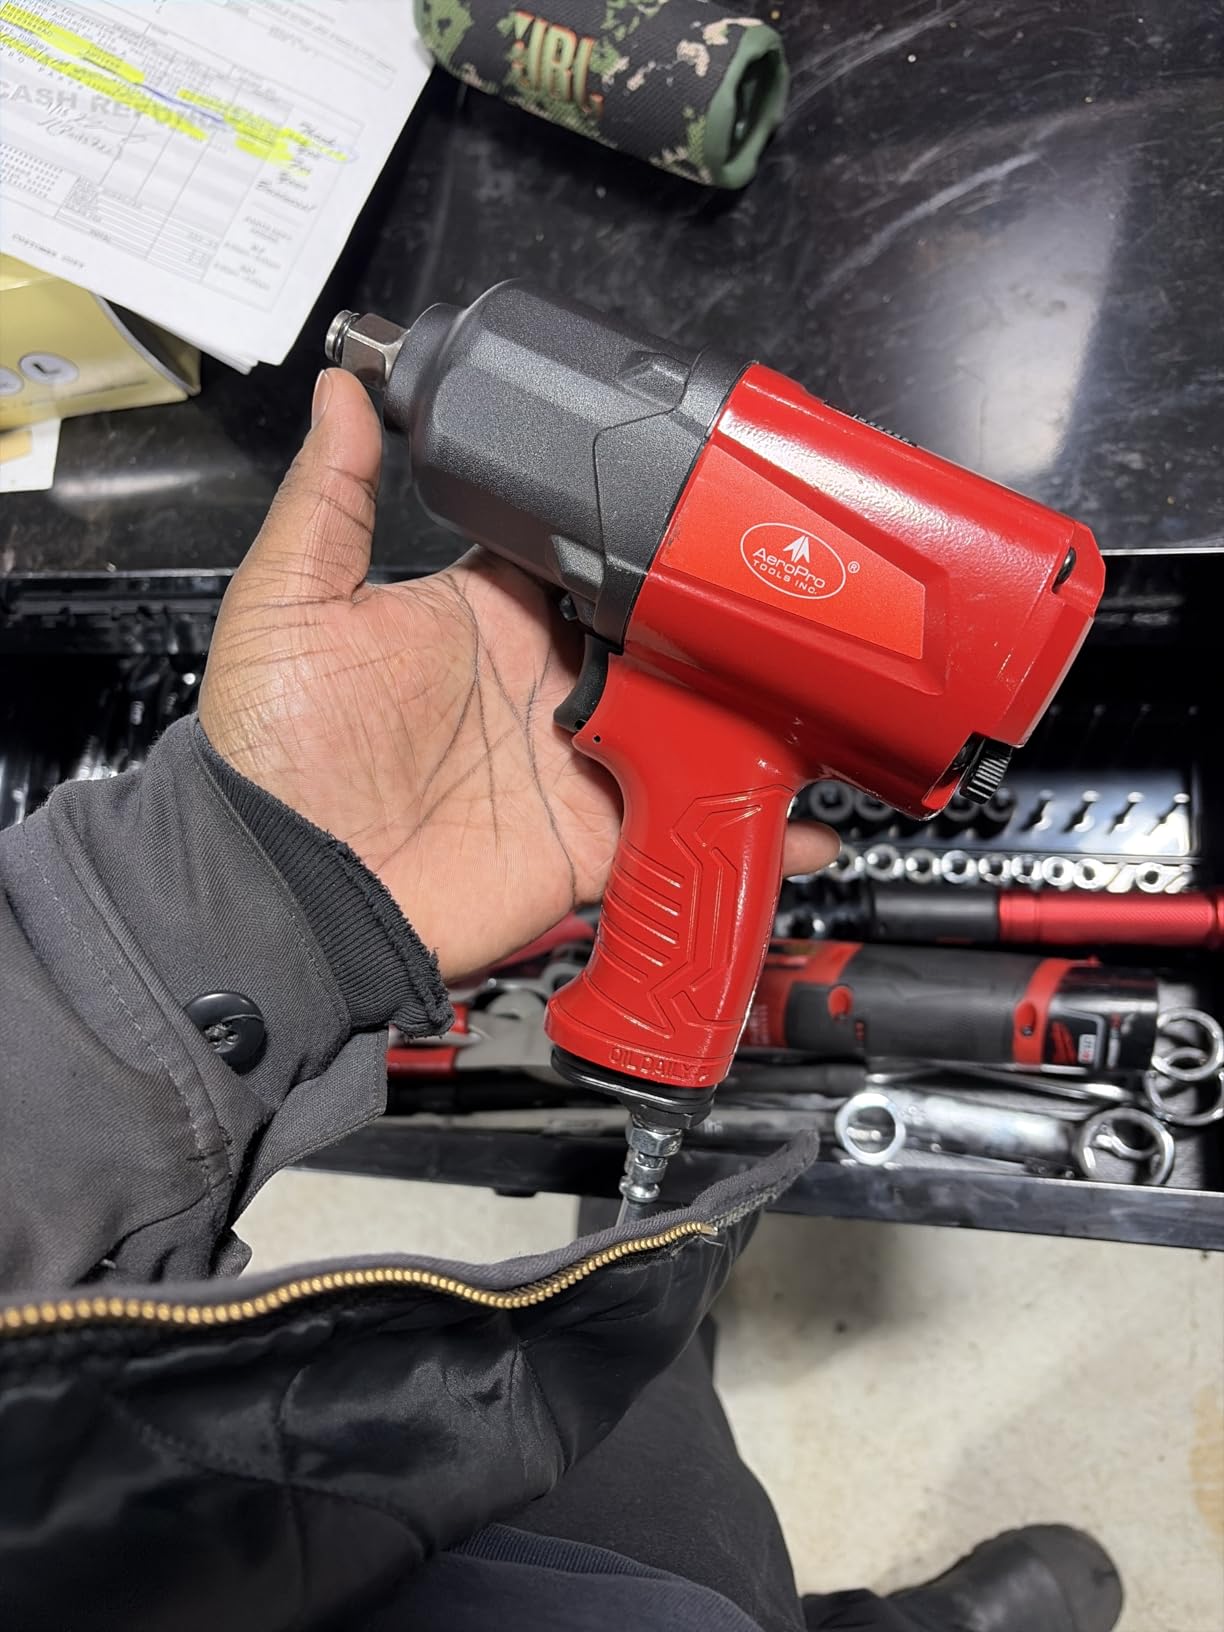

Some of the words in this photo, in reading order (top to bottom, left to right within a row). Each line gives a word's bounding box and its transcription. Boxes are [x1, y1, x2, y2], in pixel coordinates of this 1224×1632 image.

[508, 8, 605, 117] JBL
[752, 547, 826, 589] AeroPro
[753, 559, 791, 583] TOOLS
[608, 1047, 637, 1070] OIL
